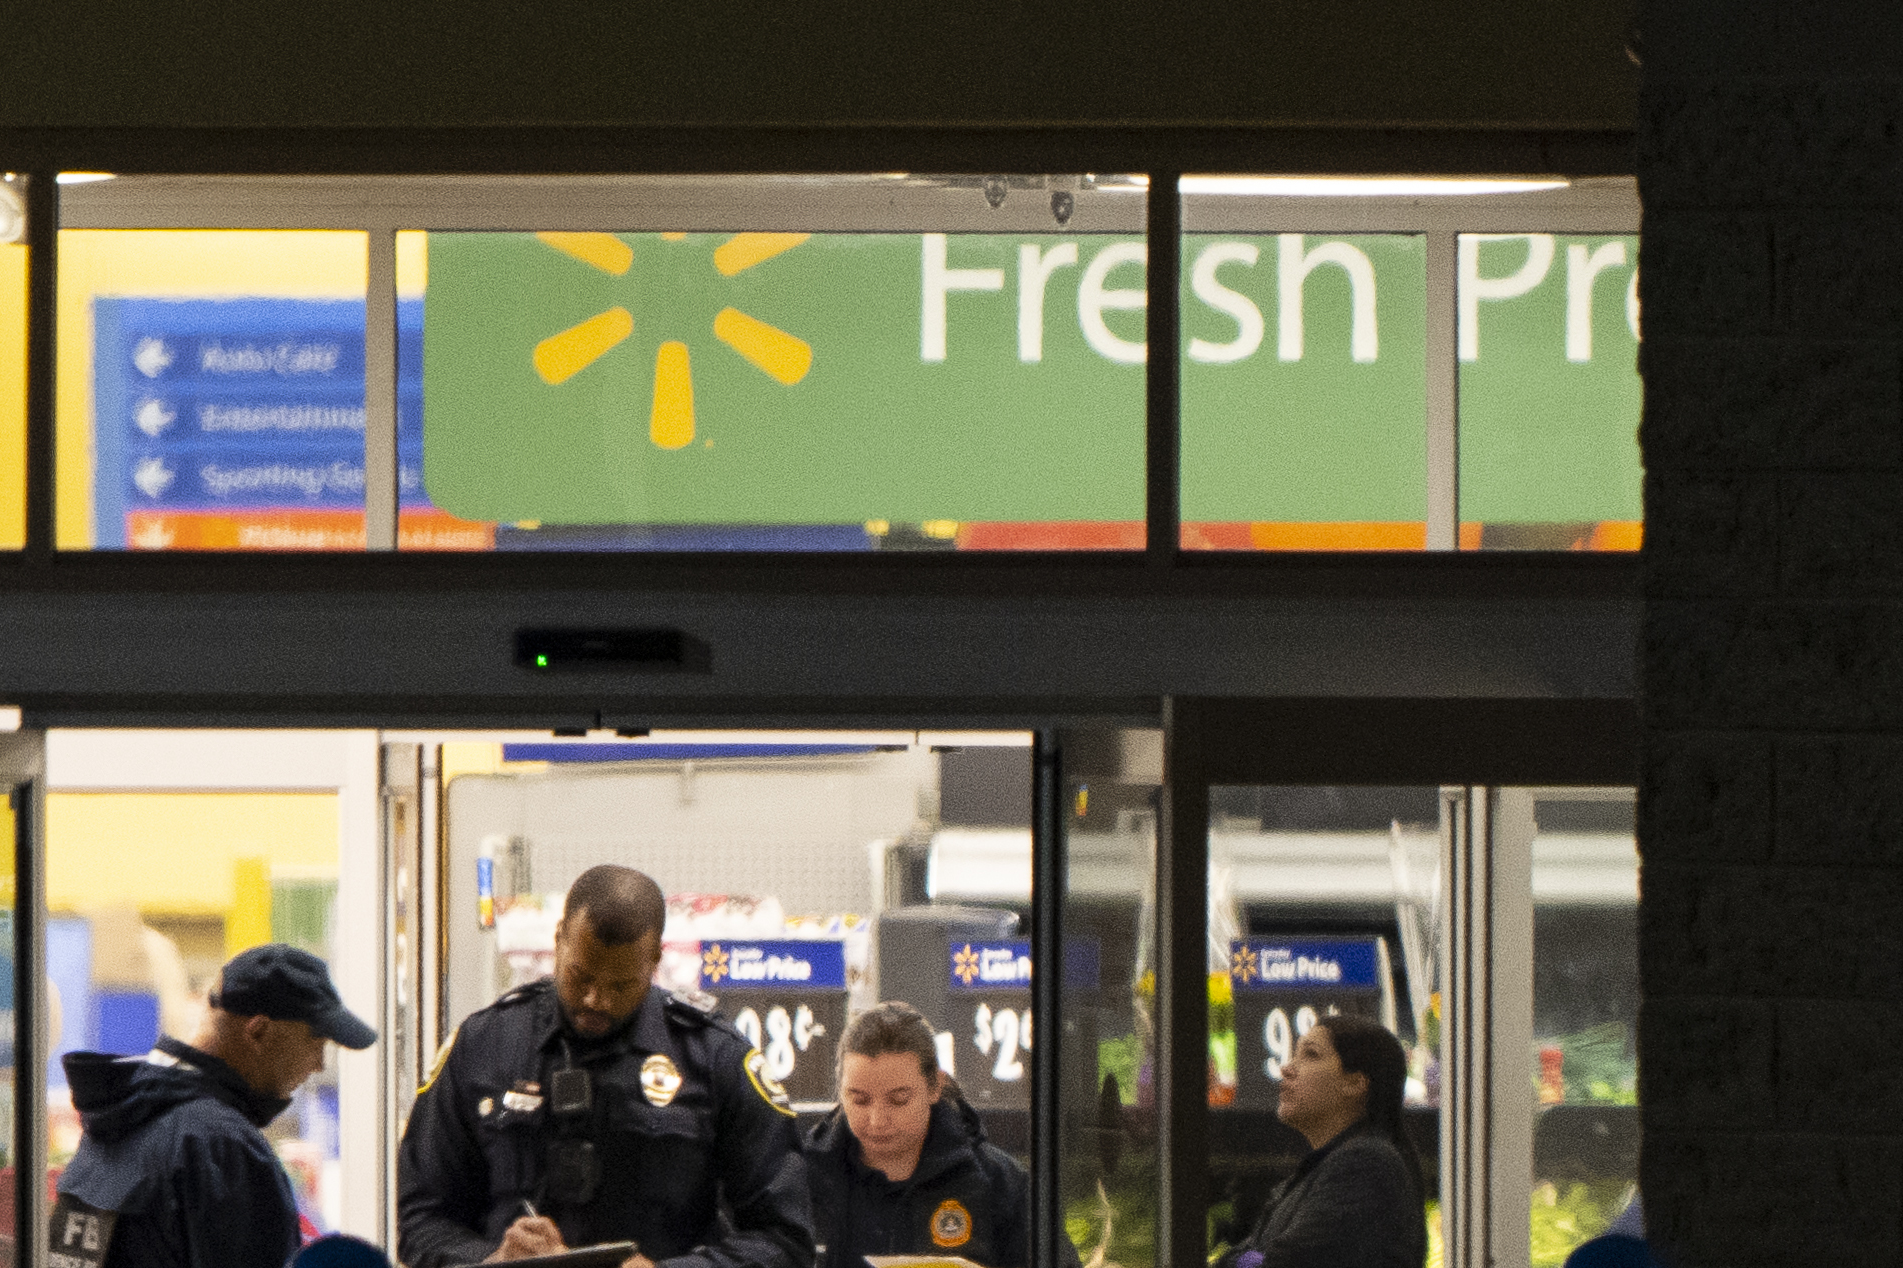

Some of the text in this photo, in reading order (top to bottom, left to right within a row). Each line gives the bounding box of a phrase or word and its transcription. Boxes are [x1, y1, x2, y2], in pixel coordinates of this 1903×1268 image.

[920, 233, 1641, 362] Fresh Pr
[1260, 954, 1341, 981] Low Price
